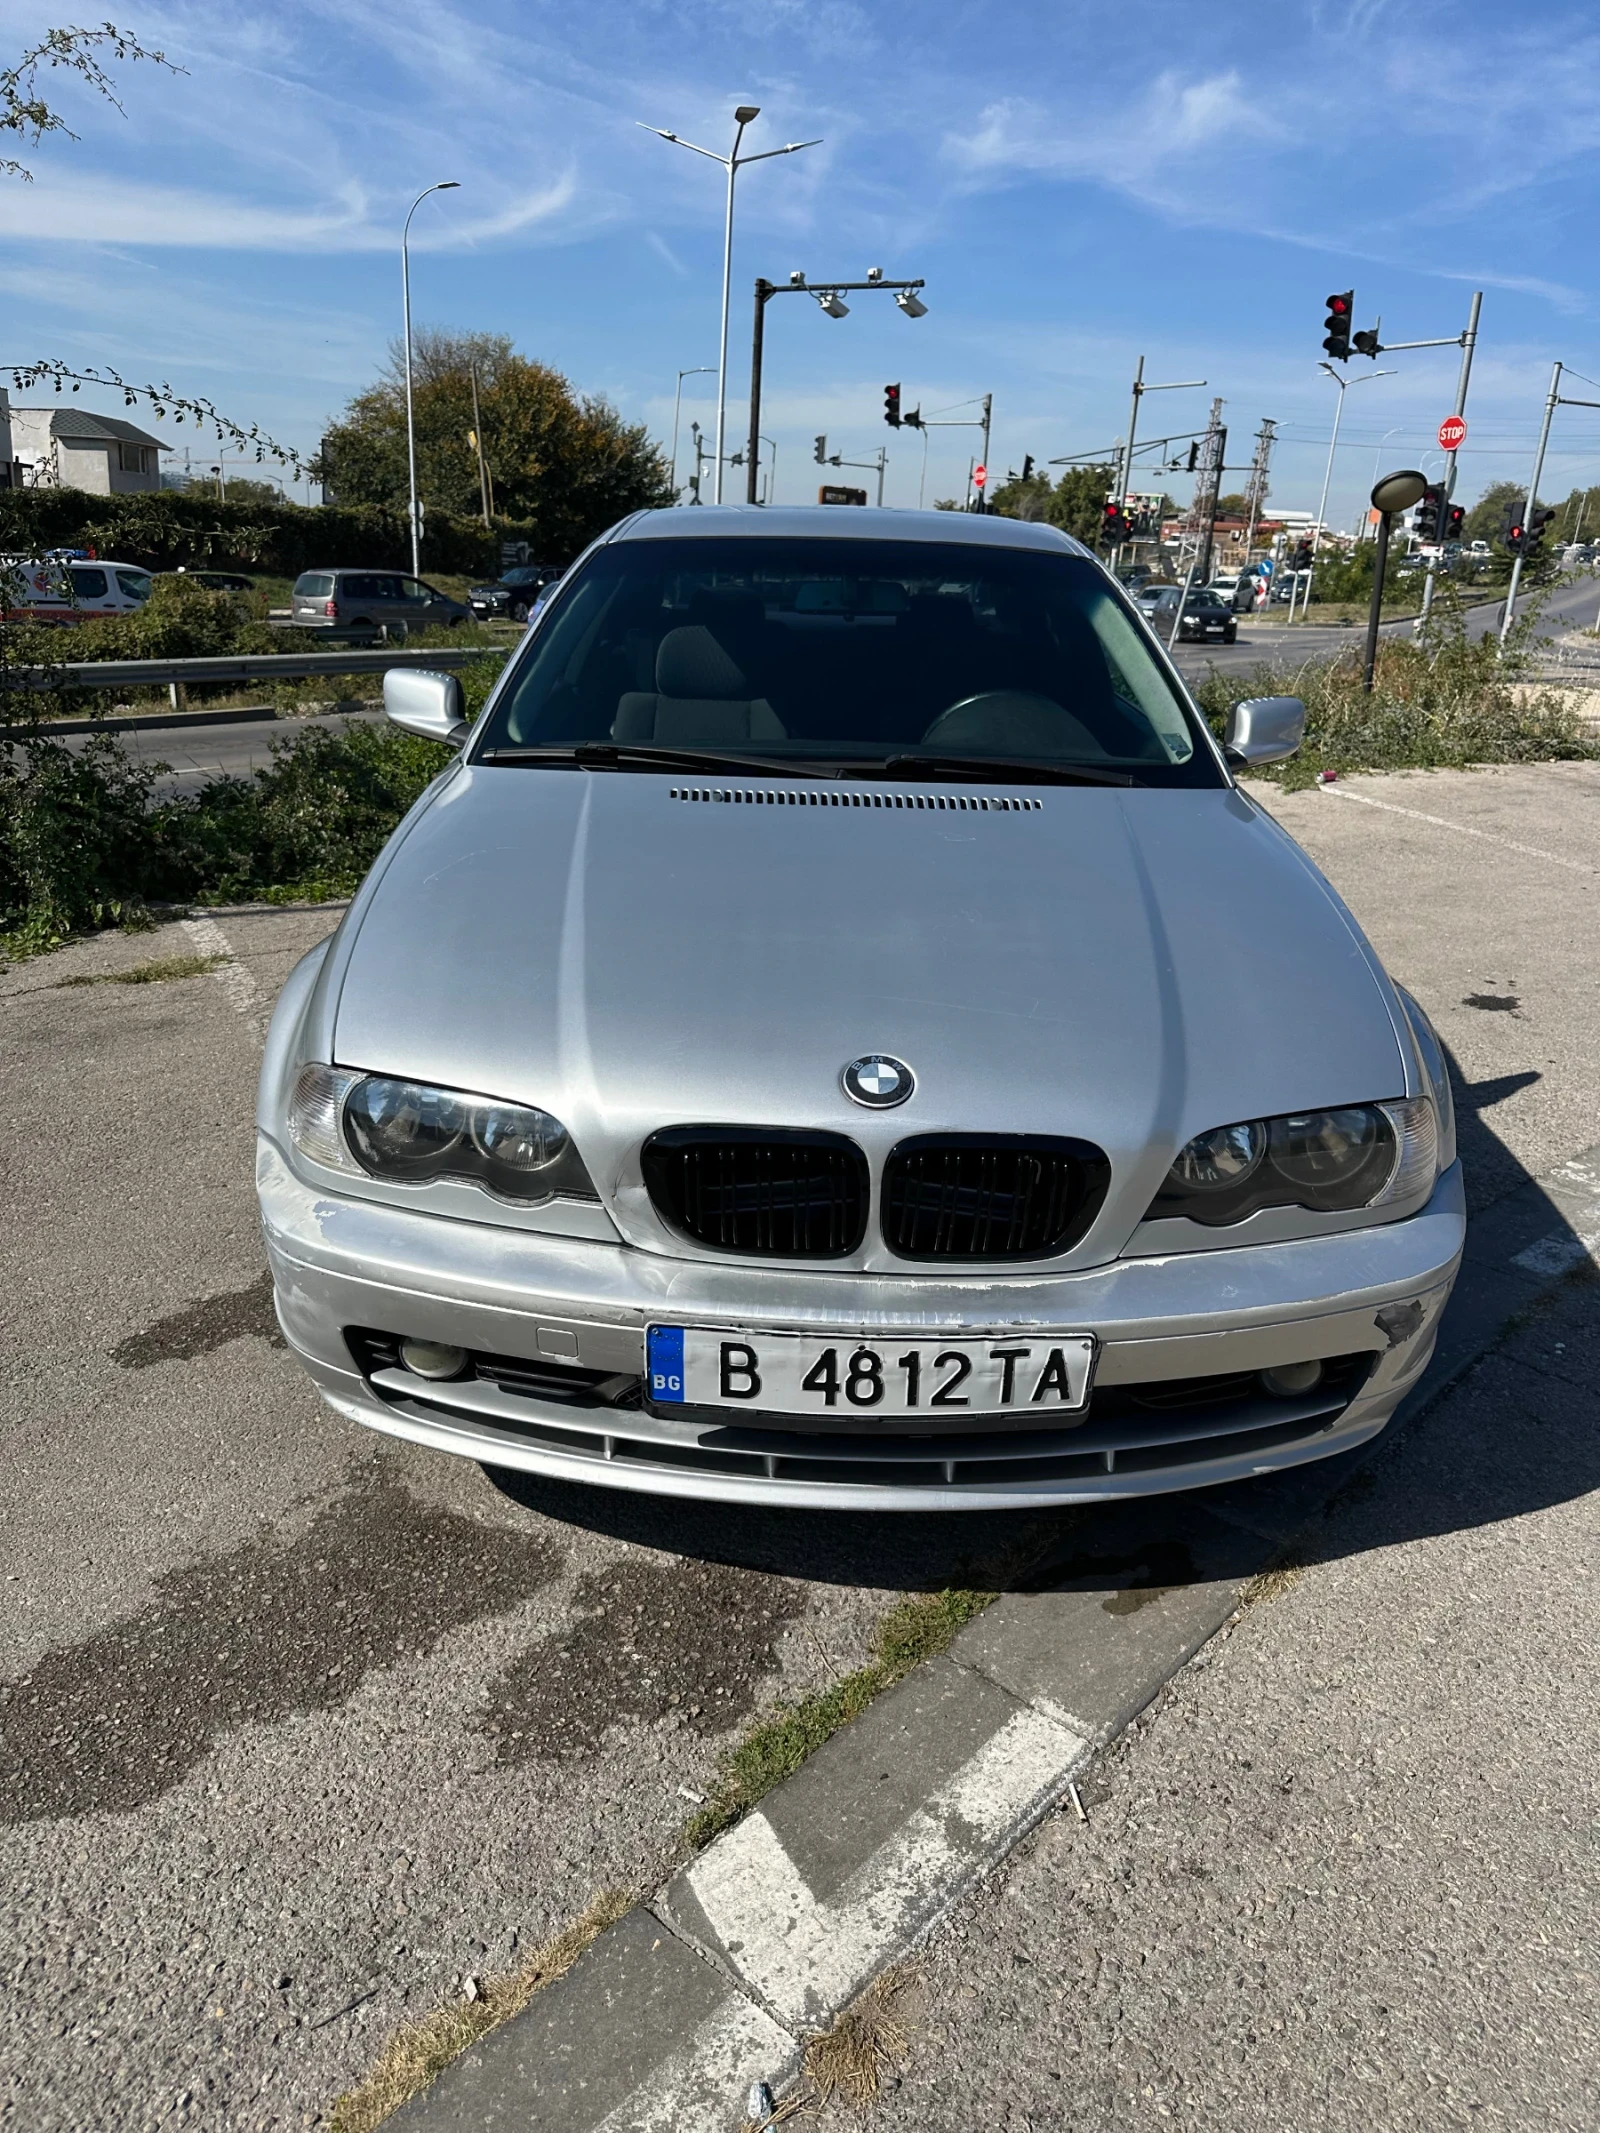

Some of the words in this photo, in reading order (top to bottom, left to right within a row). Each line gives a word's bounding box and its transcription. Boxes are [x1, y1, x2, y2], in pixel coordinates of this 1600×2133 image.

[1440, 426, 1464, 441] STOP
[851, 1056, 905, 1071] BMW
[720, 1341, 761, 1398] B
[801, 1347, 972, 1406] 4812
[989, 1347, 1071, 1404] TA
[653, 1374, 681, 1391] BG
